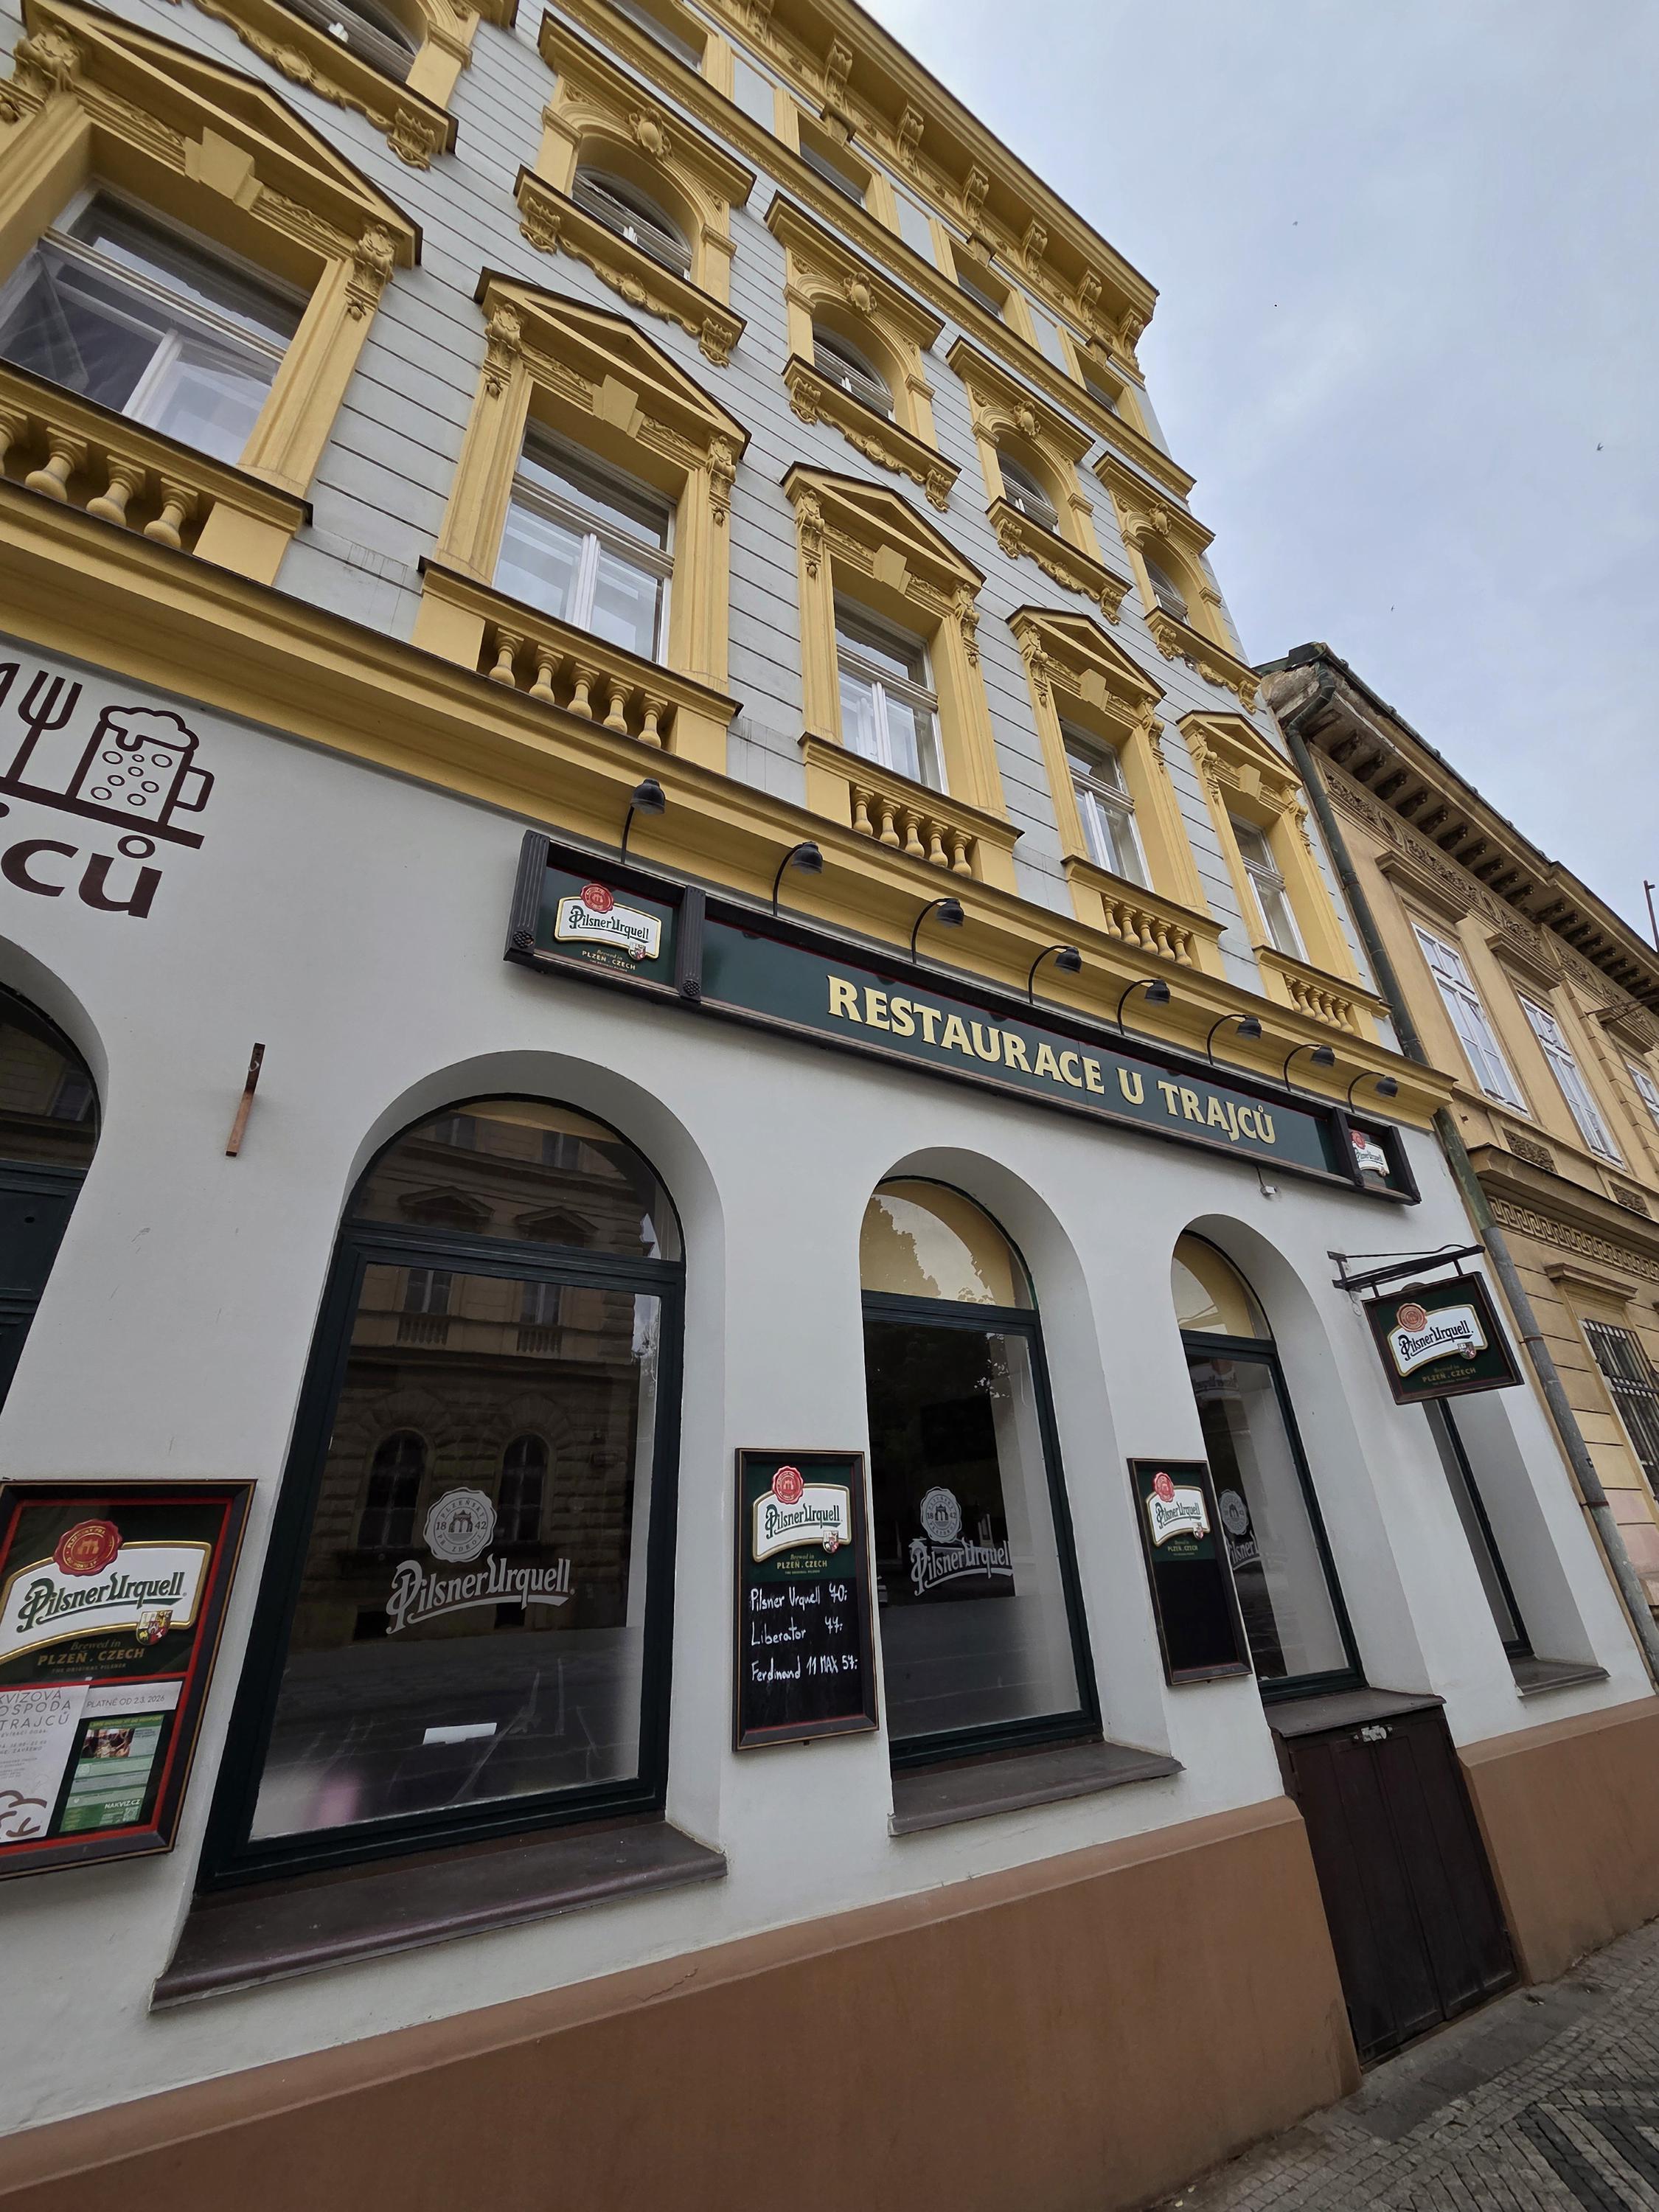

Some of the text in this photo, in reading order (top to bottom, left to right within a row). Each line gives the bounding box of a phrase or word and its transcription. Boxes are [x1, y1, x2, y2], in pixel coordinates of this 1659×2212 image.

[0, 802, 162, 919] ců
[569, 905, 649, 940] Pilsner Urquell
[612, 959, 636, 970] CZECH
[826, 974, 1276, 1144] RESTAURACE U TRAJCŮ
[1398, 1321, 1470, 1361] Pilsner Urquell
[437, 1521, 487, 1530] 18 42
[765, 1503, 840, 1540] Pilsner Urquell
[805, 1560, 827, 1568] CZECH
[911, 1537, 1012, 1596] Pilsner Urquell
[16, 1571, 185, 1633] Pilsner Urquell
[386, 1554, 571, 1635] Pilsner Urquell
[751, 1587, 785, 1612] Pilsner
[751, 1616, 806, 1646] Liberator
[38, 1648, 145, 1666] PLZEŇ CZECH
[751, 1655, 801, 1682] Ferdinand
[86, 1697, 117, 1708] PLATNÉ
[147, 1694, 165, 1703] 2026
